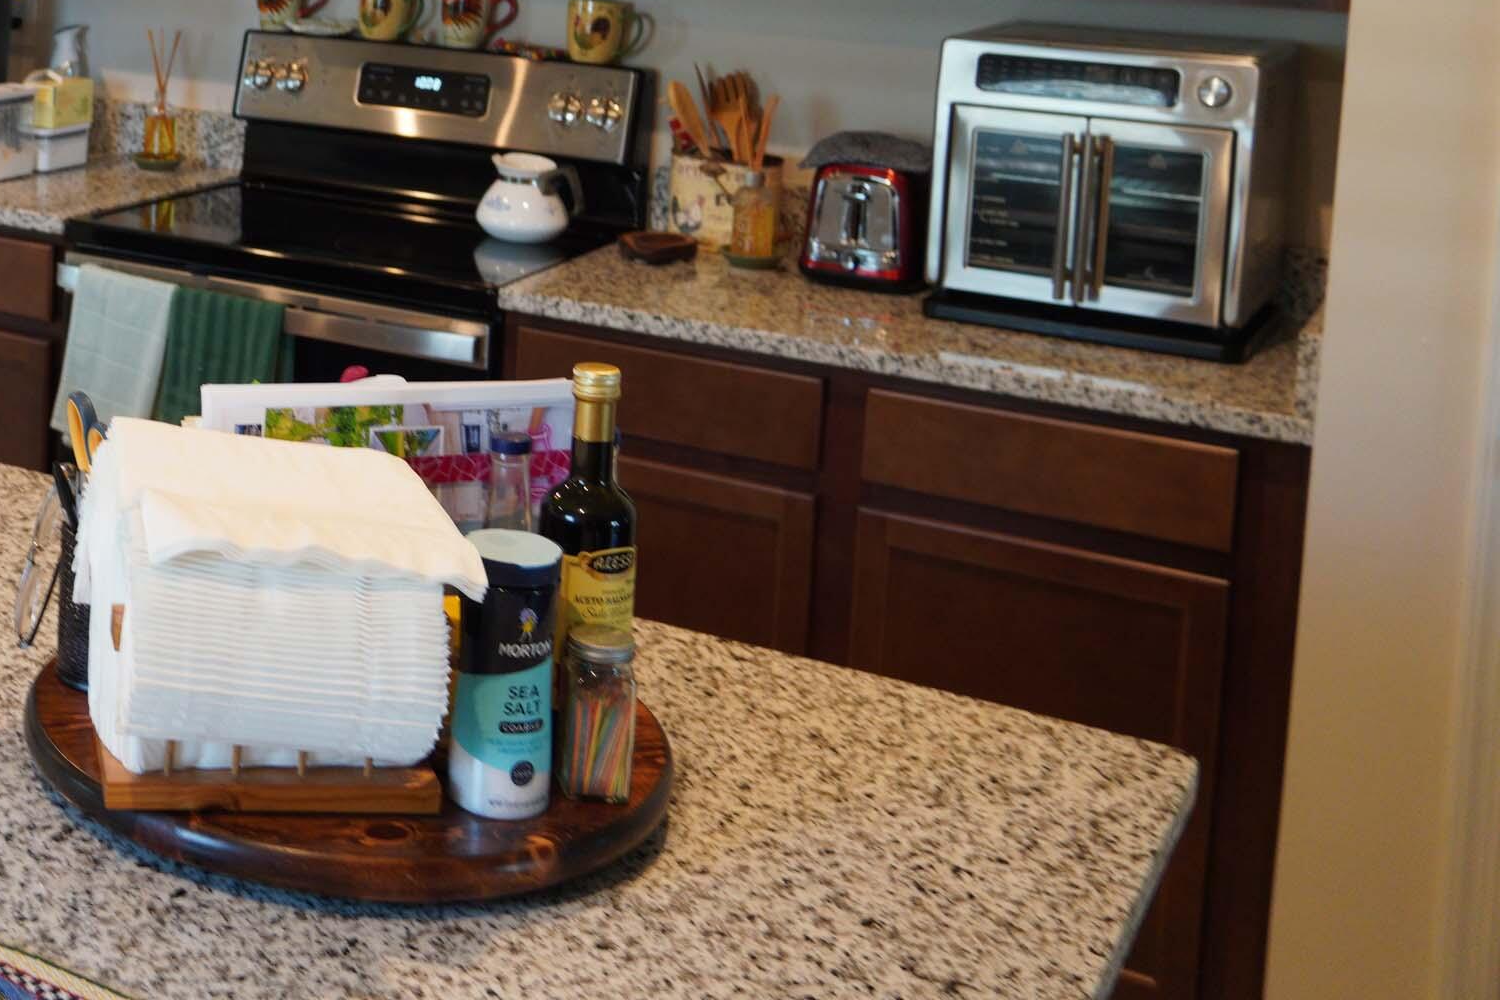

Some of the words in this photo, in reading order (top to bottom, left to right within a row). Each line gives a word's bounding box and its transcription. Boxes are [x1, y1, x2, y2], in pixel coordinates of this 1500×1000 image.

[498, 639, 552, 658] MORTON
[508, 684, 540, 700] SEA
[503, 699, 540, 716] SALT
